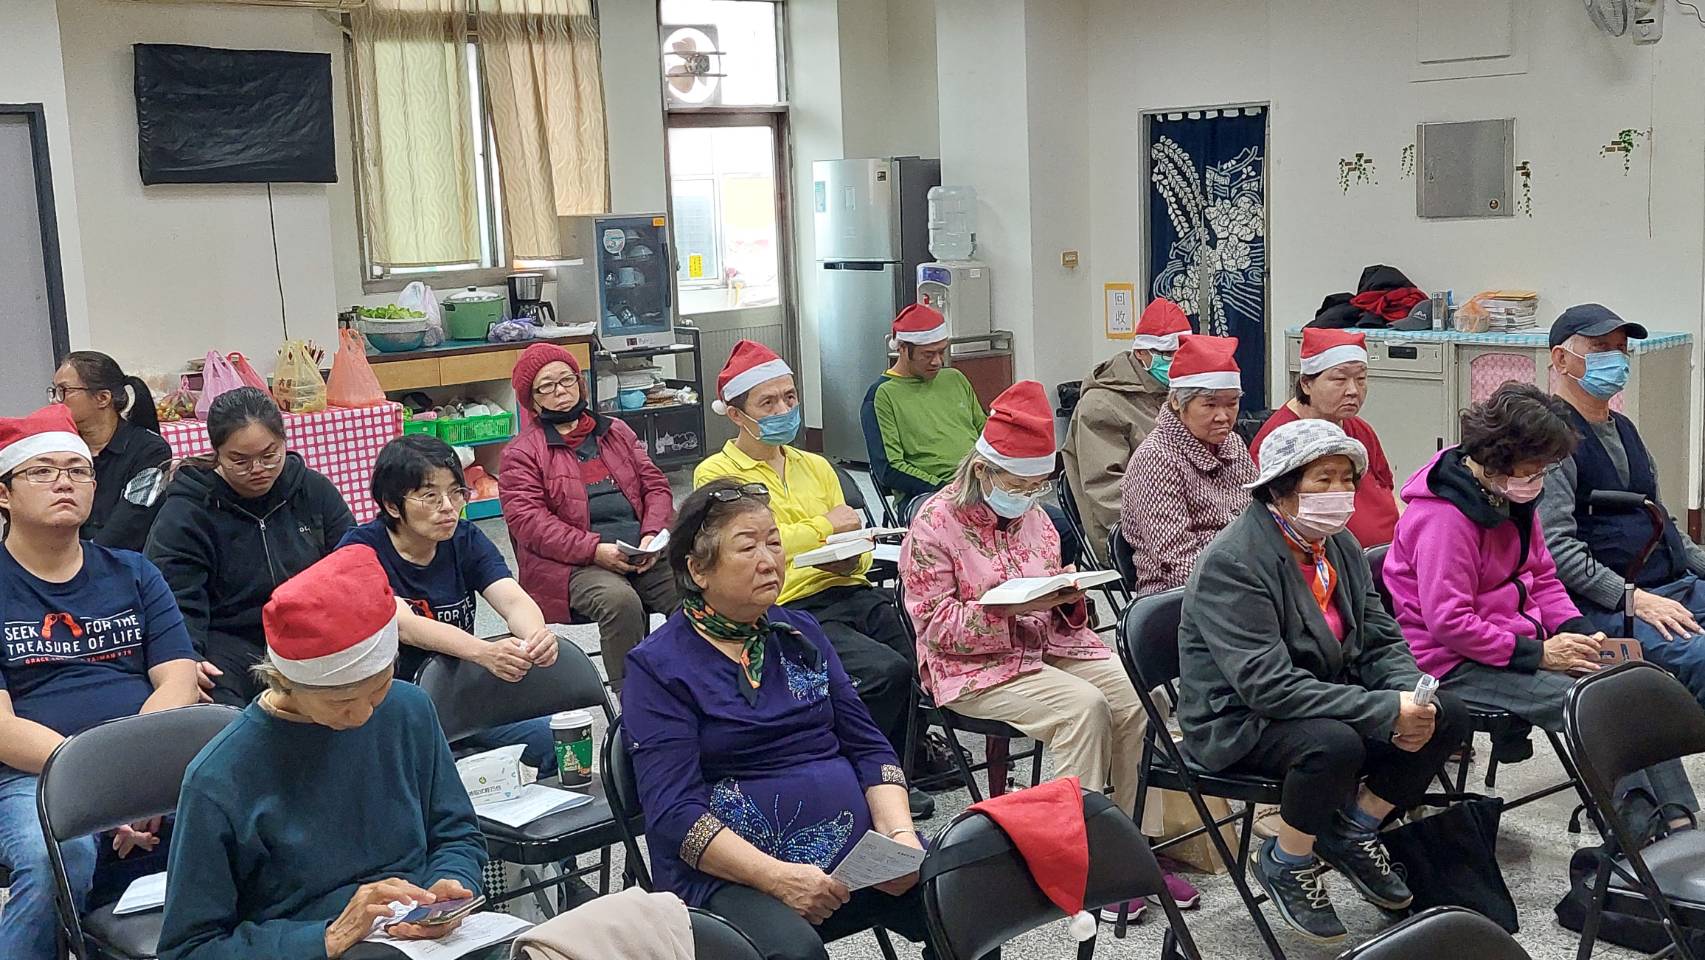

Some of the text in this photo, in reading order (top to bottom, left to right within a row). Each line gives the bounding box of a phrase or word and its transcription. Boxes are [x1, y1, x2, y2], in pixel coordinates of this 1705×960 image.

[1114, 292, 1127, 325] 回收
[4, 614, 140, 641] SEEK FOR THE
[437, 609, 460, 622] FOR
[7, 628, 143, 656] TREASURE OF LIFE
